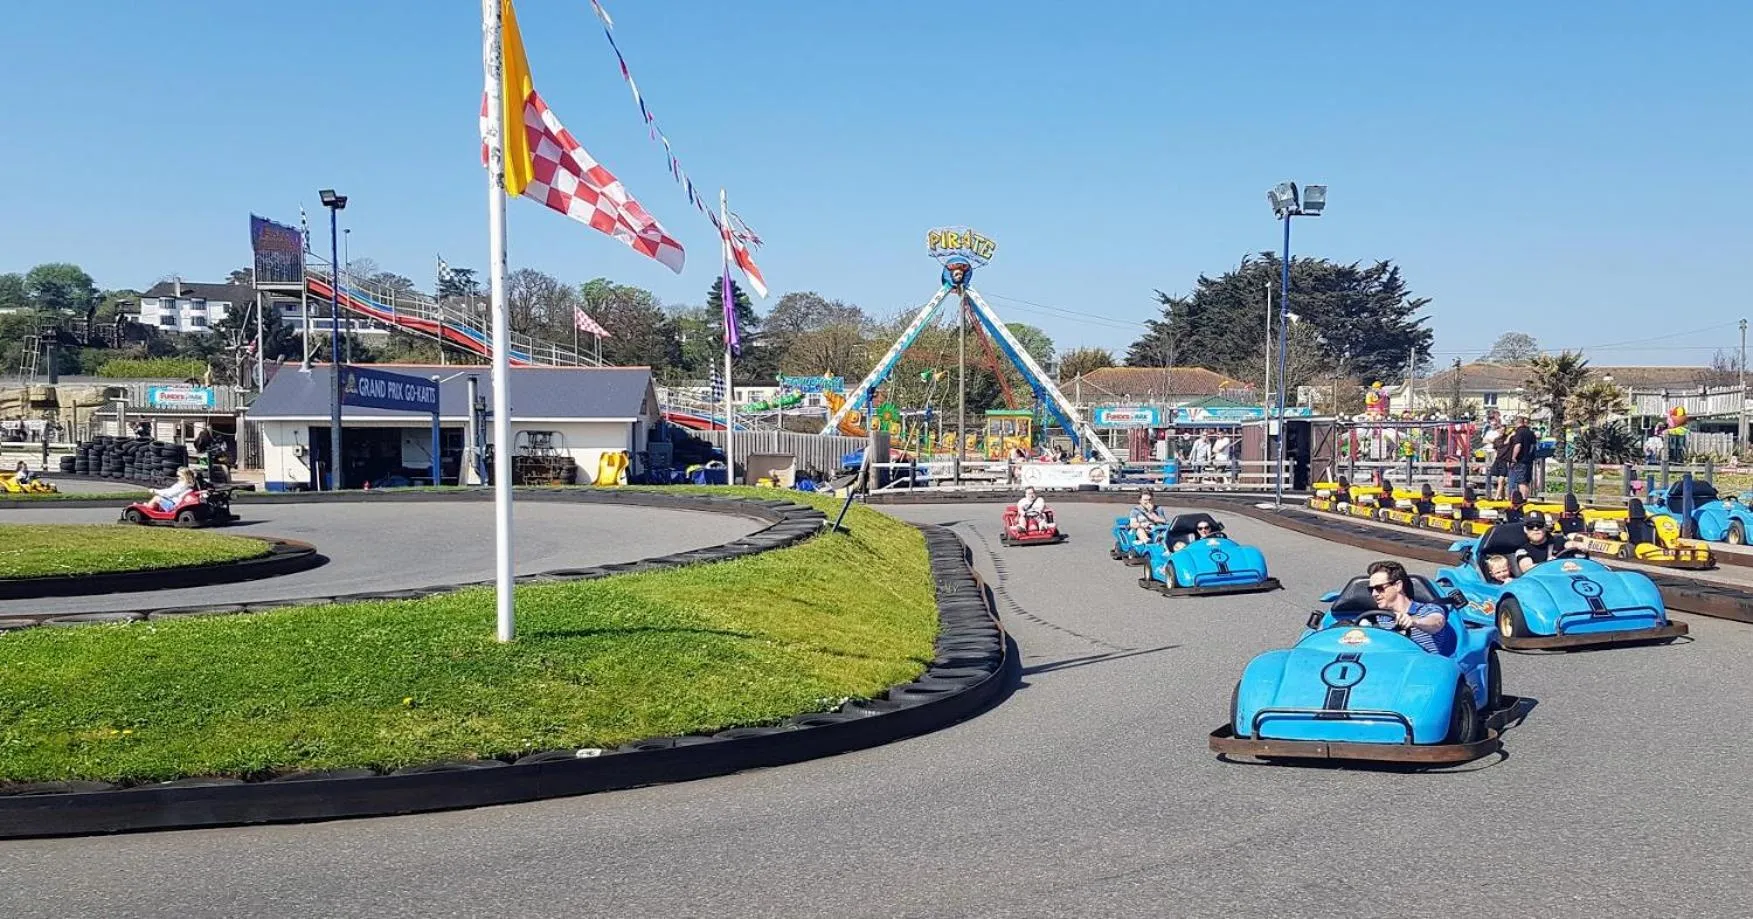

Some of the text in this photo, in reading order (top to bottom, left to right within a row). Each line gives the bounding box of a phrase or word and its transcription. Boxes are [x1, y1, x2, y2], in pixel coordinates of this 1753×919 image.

[928, 229, 996, 260] PIRATE
[359, 377, 436, 403] GRAND PRIX GO-KARTS
[1581, 582, 1594, 593] 5
[1338, 666, 1349, 680] 1
